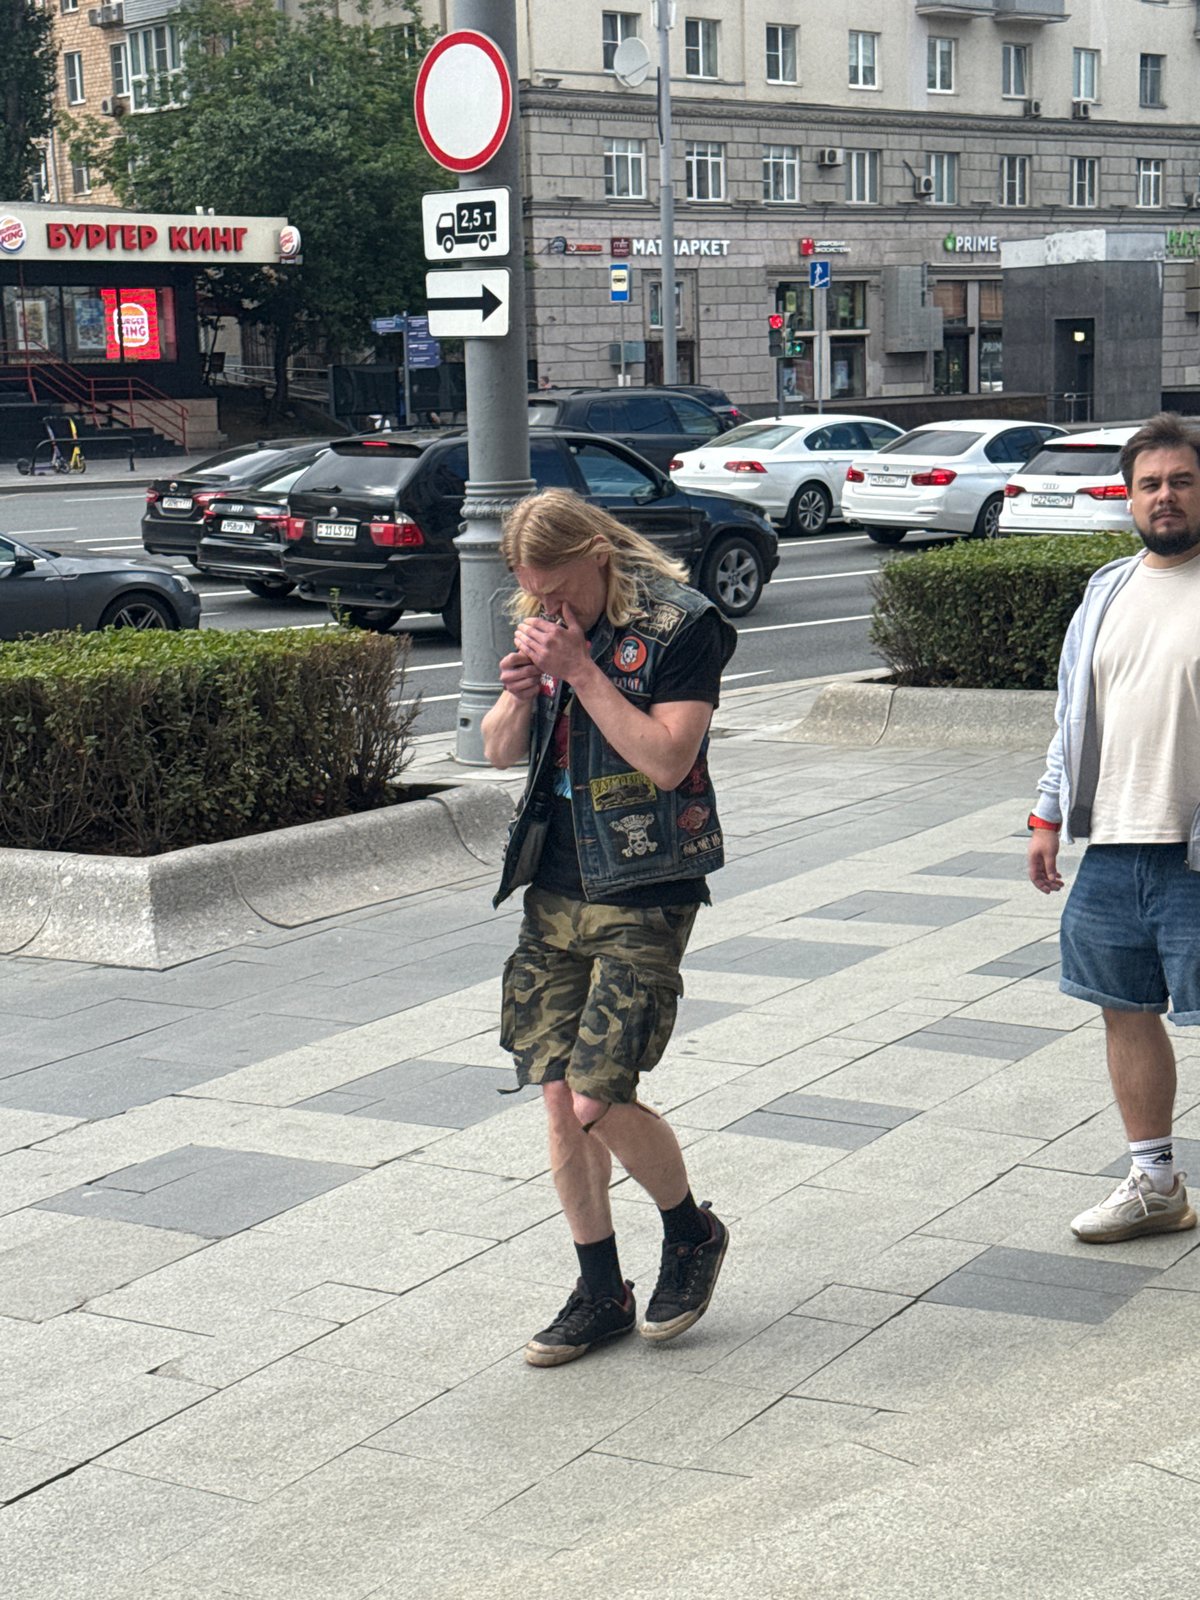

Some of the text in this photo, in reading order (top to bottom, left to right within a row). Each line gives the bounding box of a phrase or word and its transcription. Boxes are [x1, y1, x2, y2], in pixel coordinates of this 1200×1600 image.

[461, 208, 481, 230] 2,5
[47, 223, 248, 251] БУРГЕР КИНГ
[955, 236, 998, 252] PRIME
